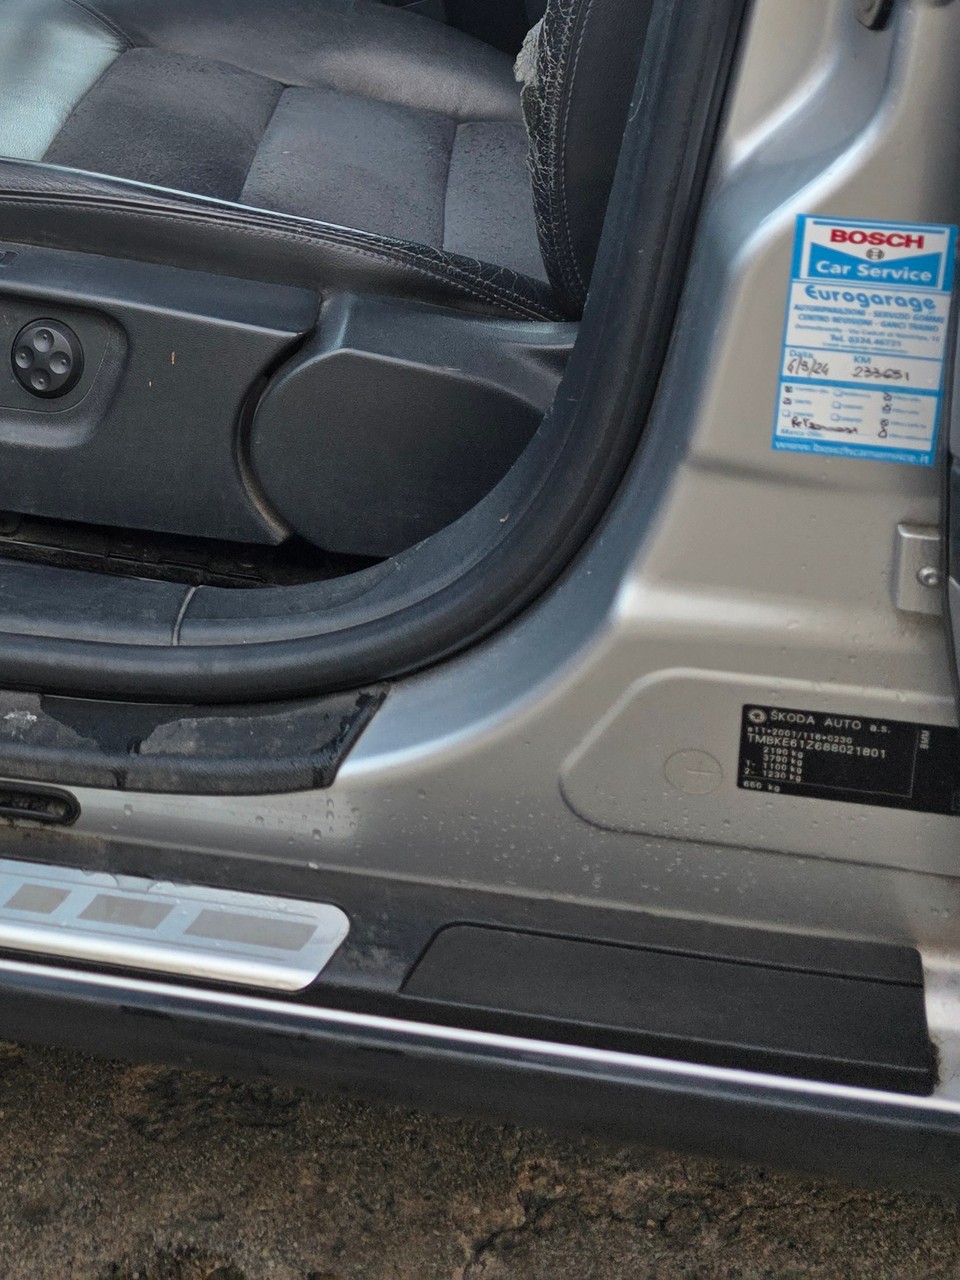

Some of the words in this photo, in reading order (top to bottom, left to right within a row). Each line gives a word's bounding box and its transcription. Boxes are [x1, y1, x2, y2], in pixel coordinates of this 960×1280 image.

[830, 228, 925, 249] BOSCH
[815, 261, 851, 276] Car
[857, 264, 932, 282] Service
[805, 285, 936, 312] Eurogarage
[853, 355, 872, 364] KM
[770, 709, 816, 725] ŠKODA
[824, 717, 862, 730] AUTO
[870, 724, 890, 733] a.s.
[791, 750, 803, 759] kg
[763, 762, 787, 771] 1100
[790, 765, 802, 775] kg
[791, 758, 803, 767] kg
[763, 770, 787, 779] 1230
[789, 773, 801, 783] kg
[767, 783, 780, 792] kg
